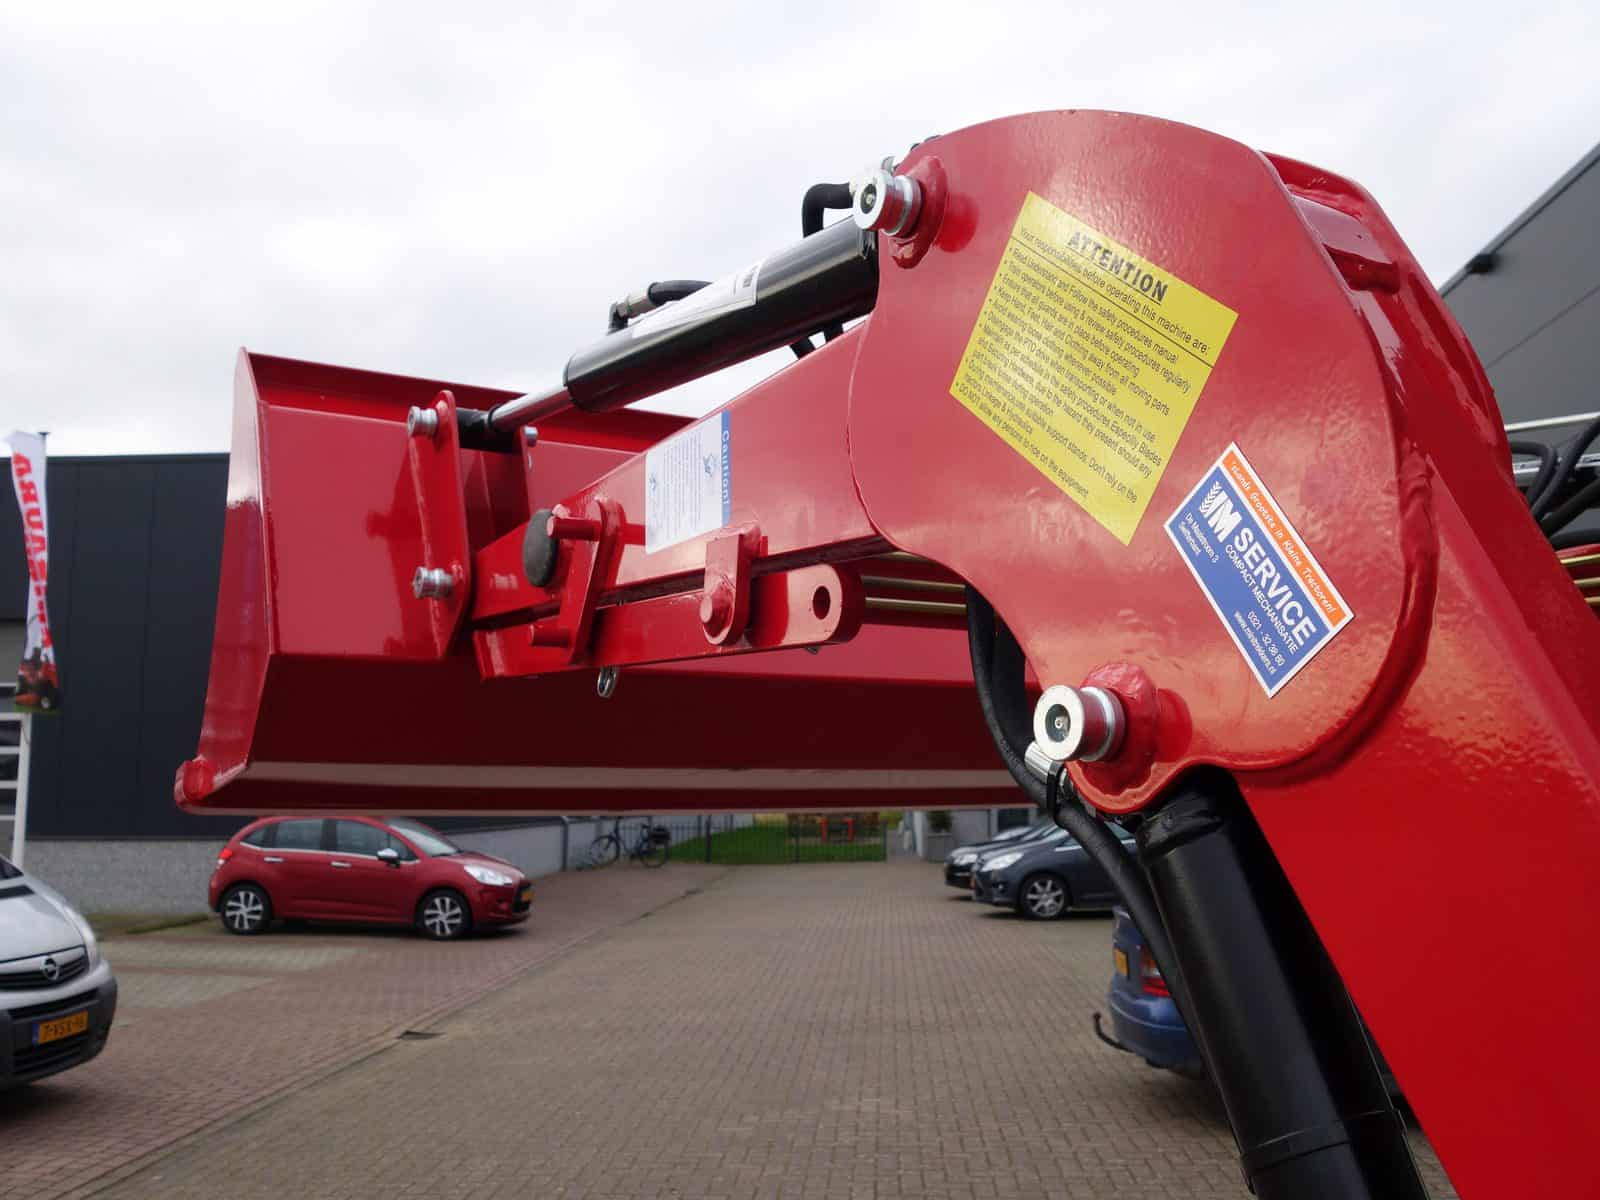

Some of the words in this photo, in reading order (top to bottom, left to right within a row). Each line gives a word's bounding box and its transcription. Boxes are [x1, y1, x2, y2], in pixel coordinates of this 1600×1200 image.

[1067, 228, 1170, 303] ATTENTION
[1067, 284, 1089, 305] Follow
[1097, 306, 1118, 327] safety
[1115, 318, 1153, 348] procedures
[1151, 342, 1179, 365] manual
[1081, 265, 1106, 288] before
[1105, 282, 1142, 314] operating
[1140, 302, 1157, 321] this
[1156, 315, 1192, 343] machine
[1191, 337, 1212, 355] are:
[1089, 334, 1111, 356] before
[1109, 349, 1140, 379] operating
[1103, 362, 1120, 380] from
[1126, 380, 1153, 406] moving
[1149, 398, 1170, 416] parts
[1104, 328, 1124, 350] safety
[1122, 342, 1161, 373] procedures
[1159, 366, 1191, 396] regularly
[1274, 526, 1285, 540] in
[1223, 542, 1255, 589] COMPACT
[1251, 584, 1299, 655] MECHANISATIE
[1231, 524, 1317, 647] SERVICE
[1246, 609, 1262, 631] 0321
[1261, 632, 1272, 646] 32
